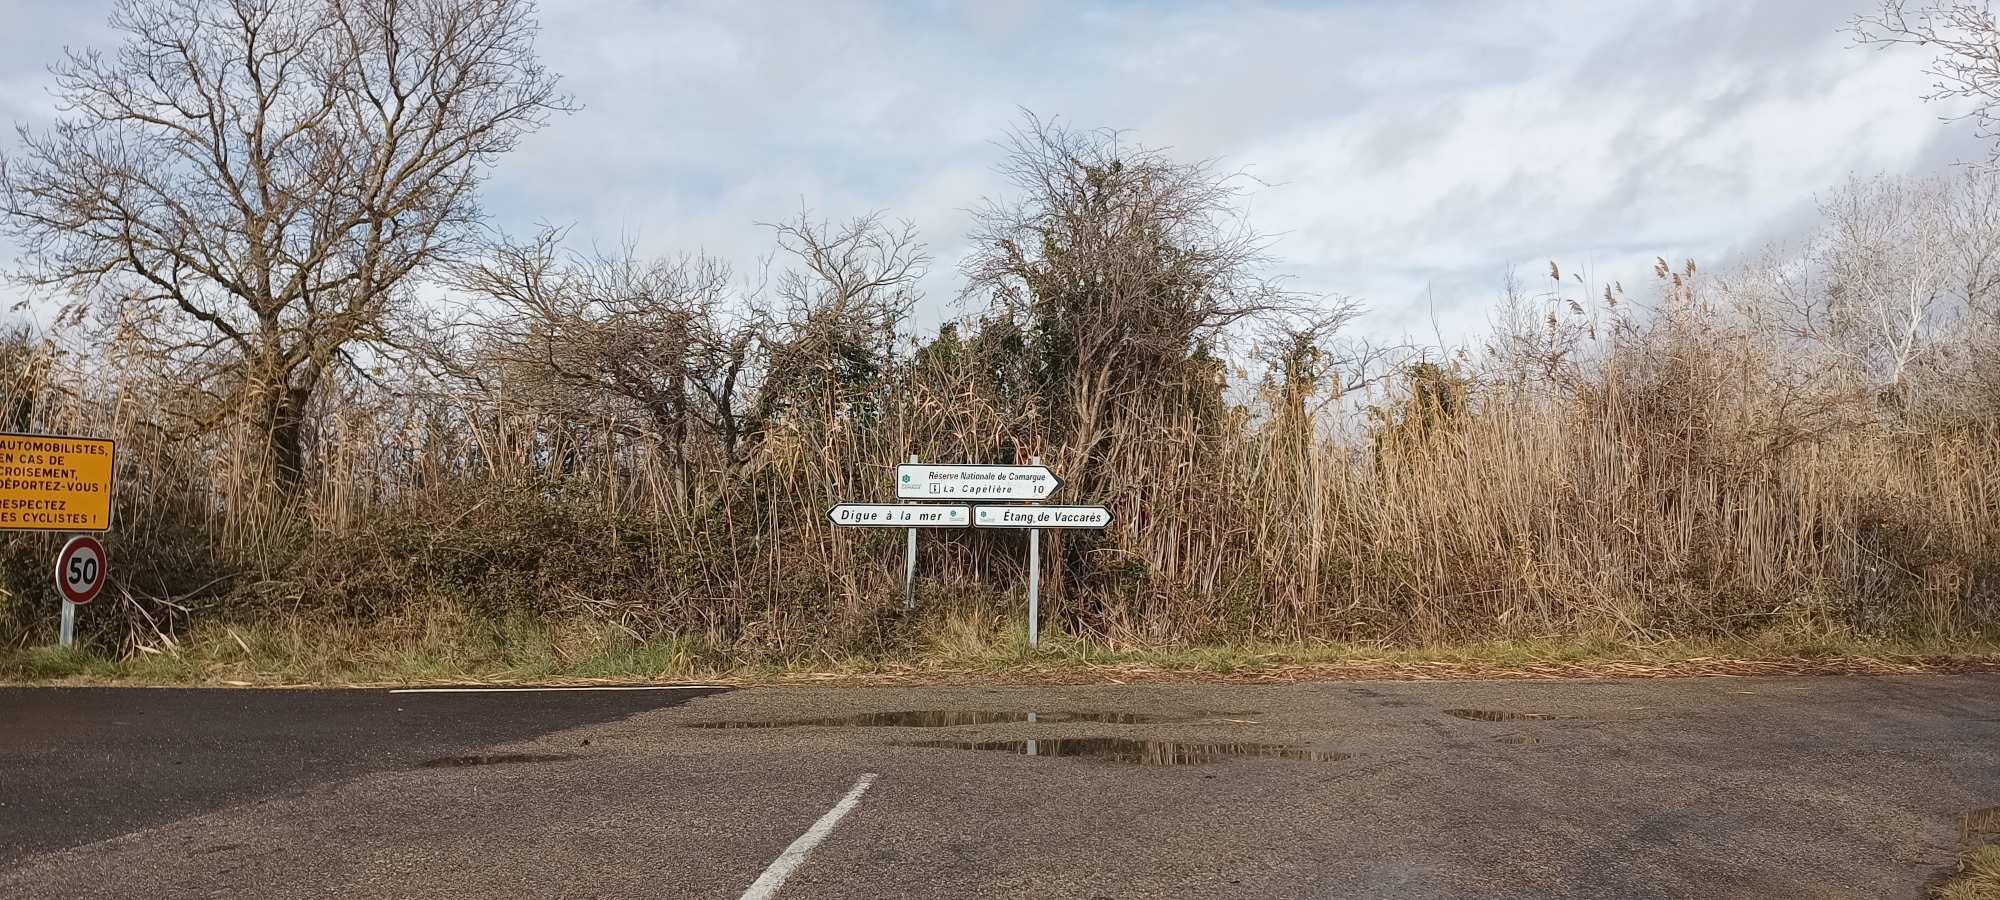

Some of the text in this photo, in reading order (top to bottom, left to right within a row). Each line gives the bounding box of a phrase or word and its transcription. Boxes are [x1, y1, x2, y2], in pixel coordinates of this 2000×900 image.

[0, 441, 108, 456] AUTOMOBILISTES,
[0, 454, 64, 465] EN CAS DE
[929, 471, 1046, 483] Réserve Nationale de Camargue
[943, 484, 955, 493] La
[1033, 485, 1044, 493] 10
[0, 499, 66, 510] ESPECTEZ
[23, 513, 88, 523] CYCLISTES
[841, 509, 878, 522] Digue
[886, 510, 893, 520] à
[900, 510, 911, 520] la
[1003, 509, 1101, 524] Étang de Vaccarès
[69, 557, 97, 584] 50
